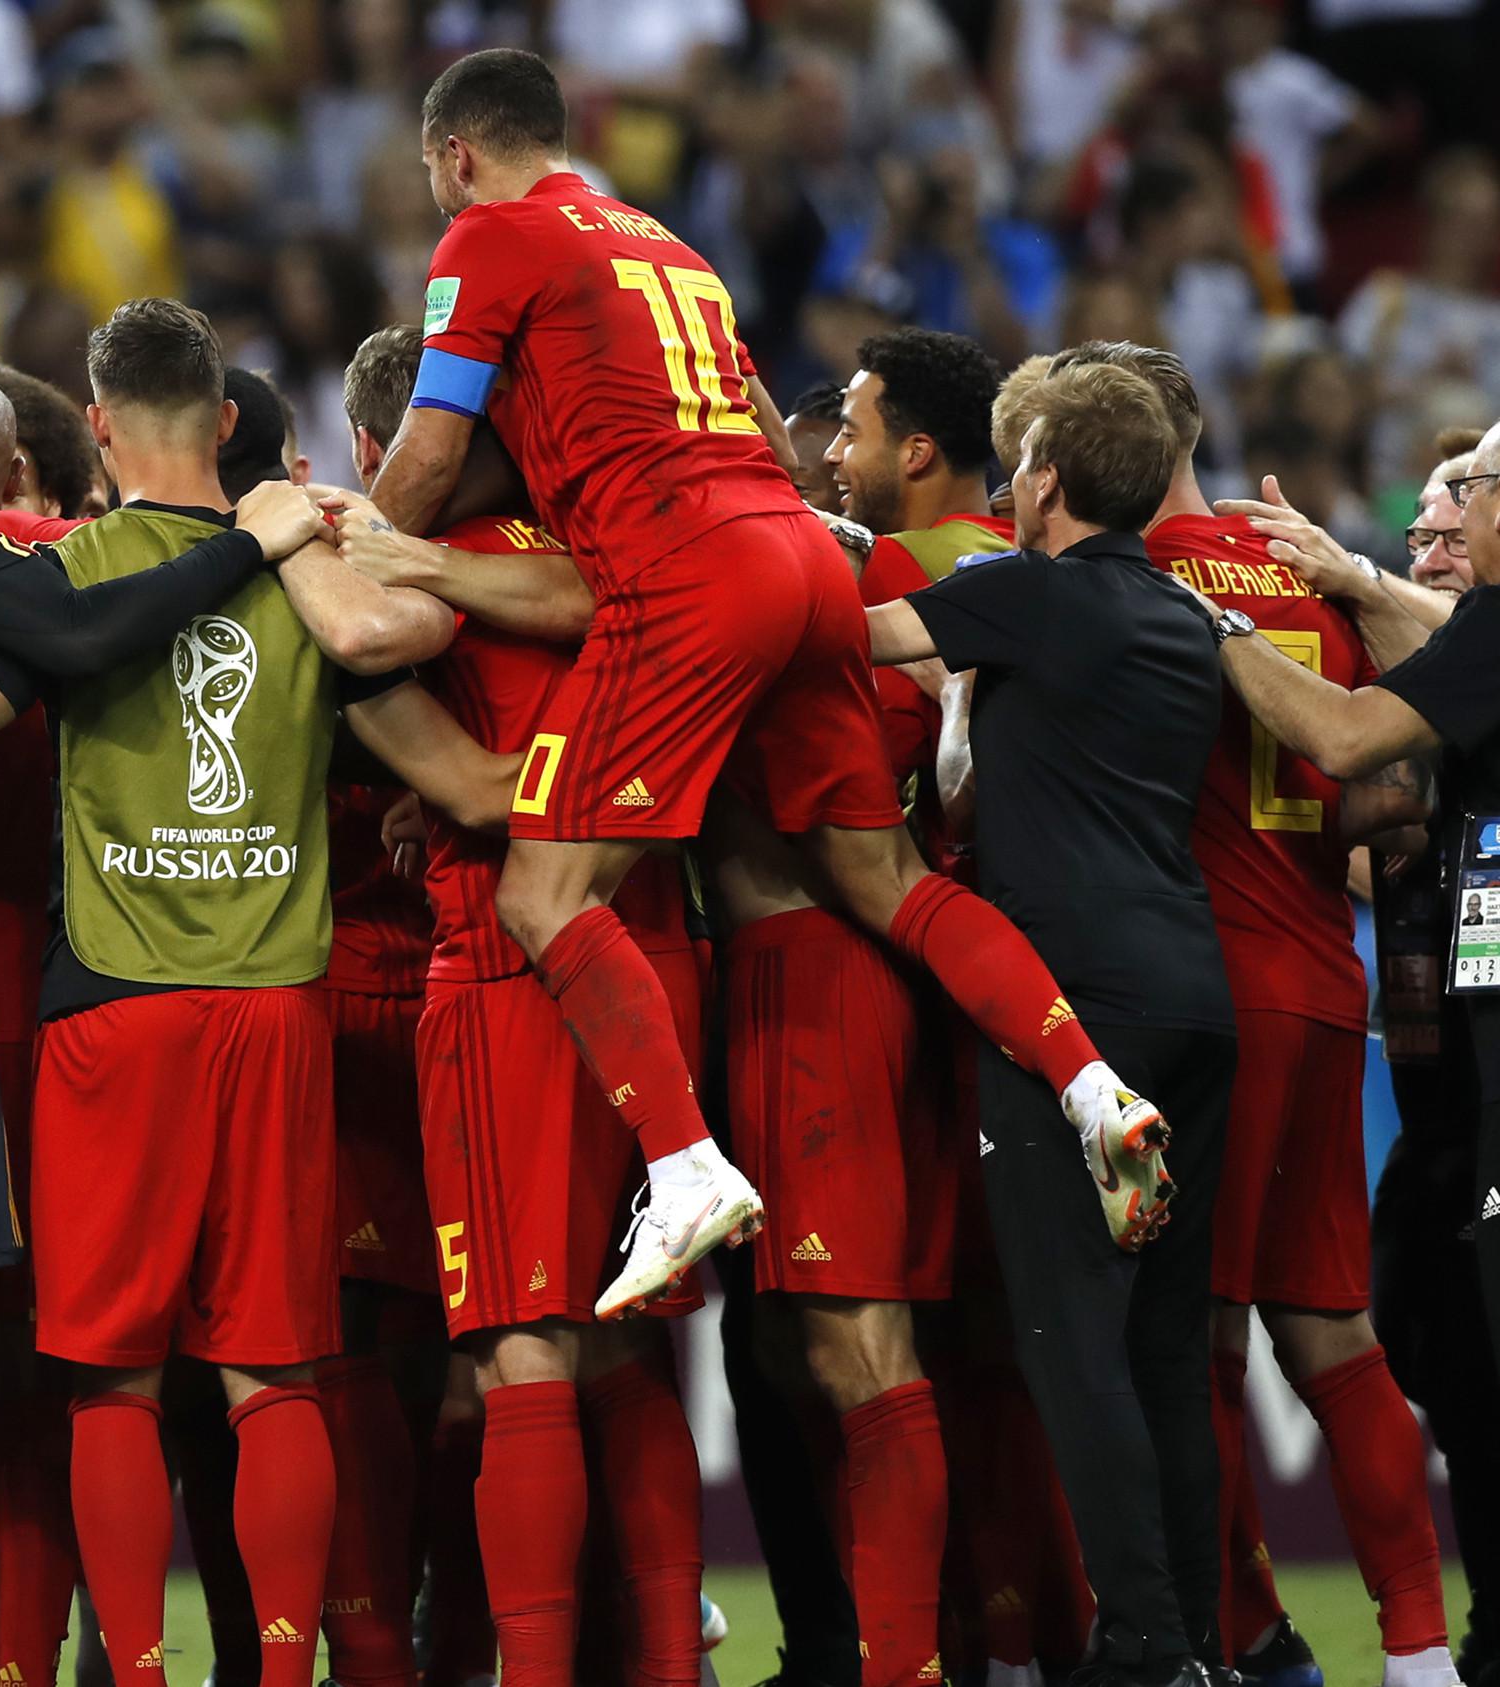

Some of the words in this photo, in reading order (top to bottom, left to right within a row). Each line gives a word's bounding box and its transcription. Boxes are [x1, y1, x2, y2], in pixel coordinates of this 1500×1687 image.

[429, 295, 453, 303] VING
[610, 258, 762, 436] 10
[1170, 558, 1323, 600] ALDERWEI
[612, 795, 655, 807] adidas
[152, 827, 189, 843] FIFA
[190, 828, 245, 843] WORLD
[247, 825, 277, 842] CUP
[102, 842, 238, 880] RUSSIA
[242, 844, 298, 878] 201
[1041, 1010, 1078, 1036] adida
[436, 1221, 467, 1310] 5
[791, 1250, 832, 1262] adidas
[261, 1633, 305, 1643] adidas
